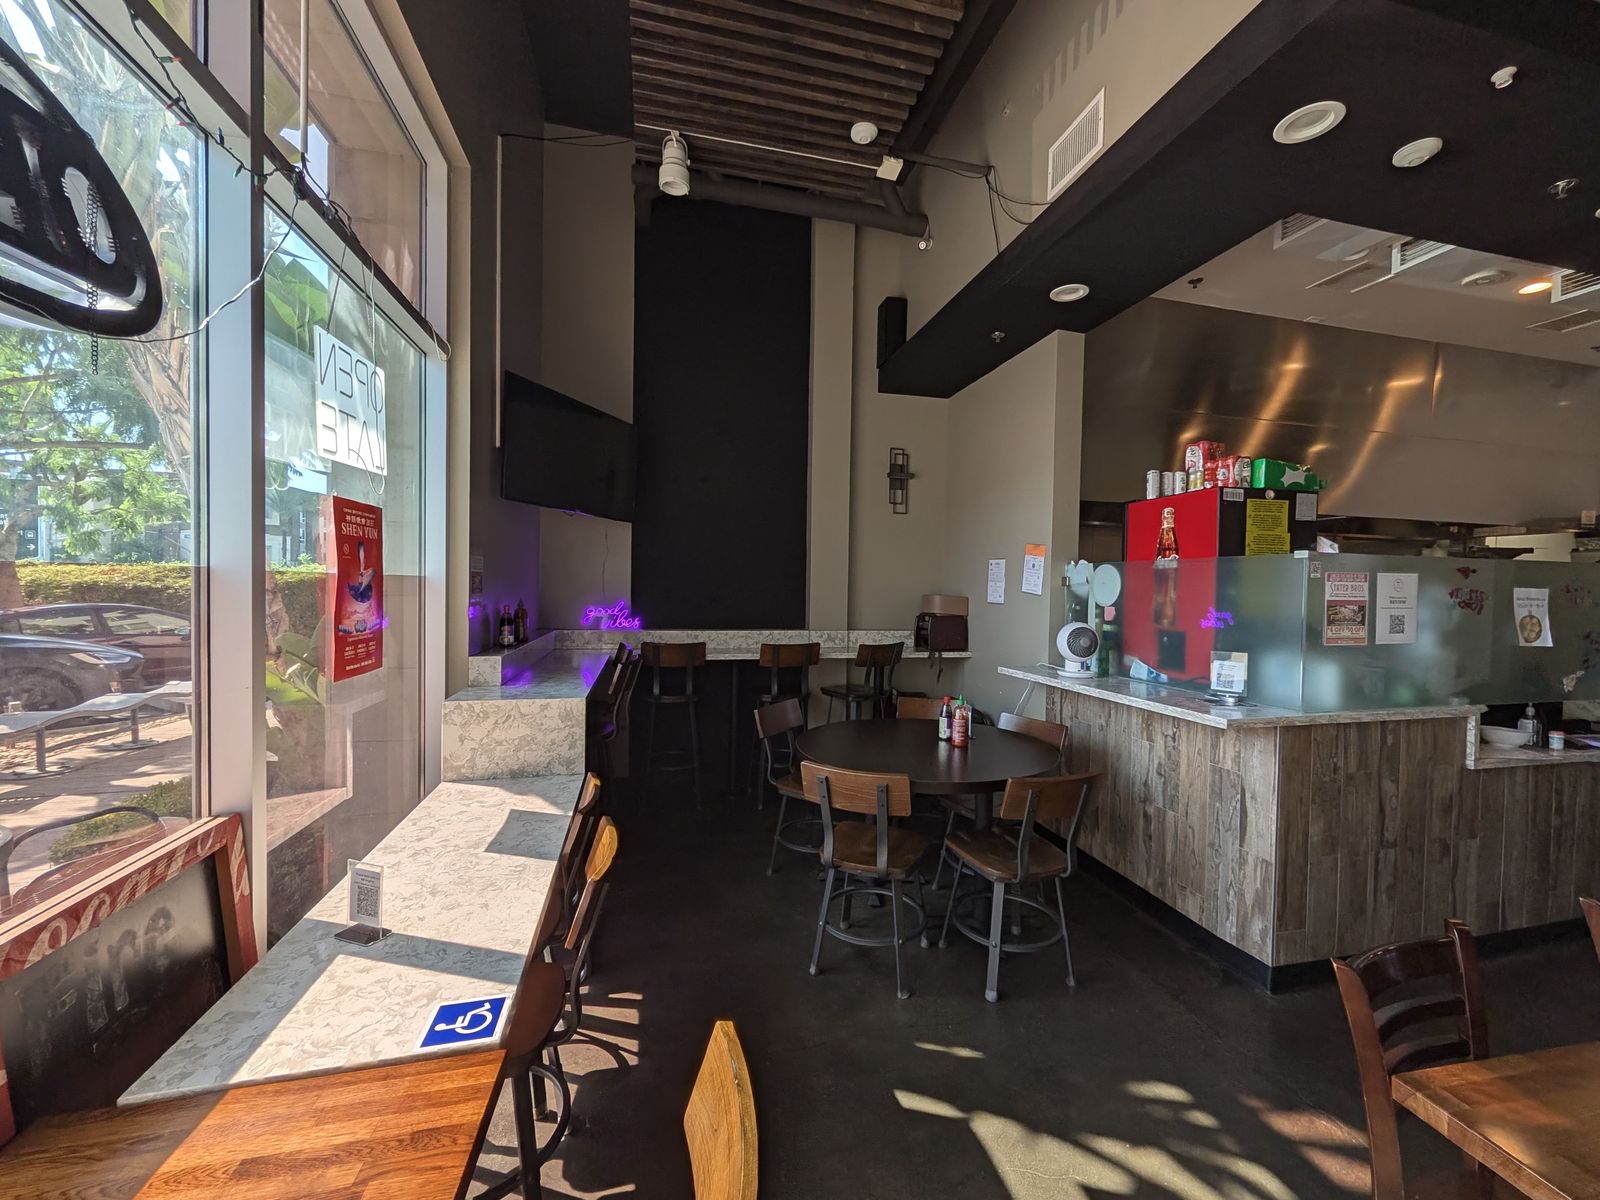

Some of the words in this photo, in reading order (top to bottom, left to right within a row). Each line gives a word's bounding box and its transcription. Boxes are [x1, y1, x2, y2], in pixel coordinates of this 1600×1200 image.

[341, 522, 363, 537] SHEN
[363, 526, 378, 540] YUN
[583, 600, 625, 625] good
[601, 609, 641, 629] vibes
